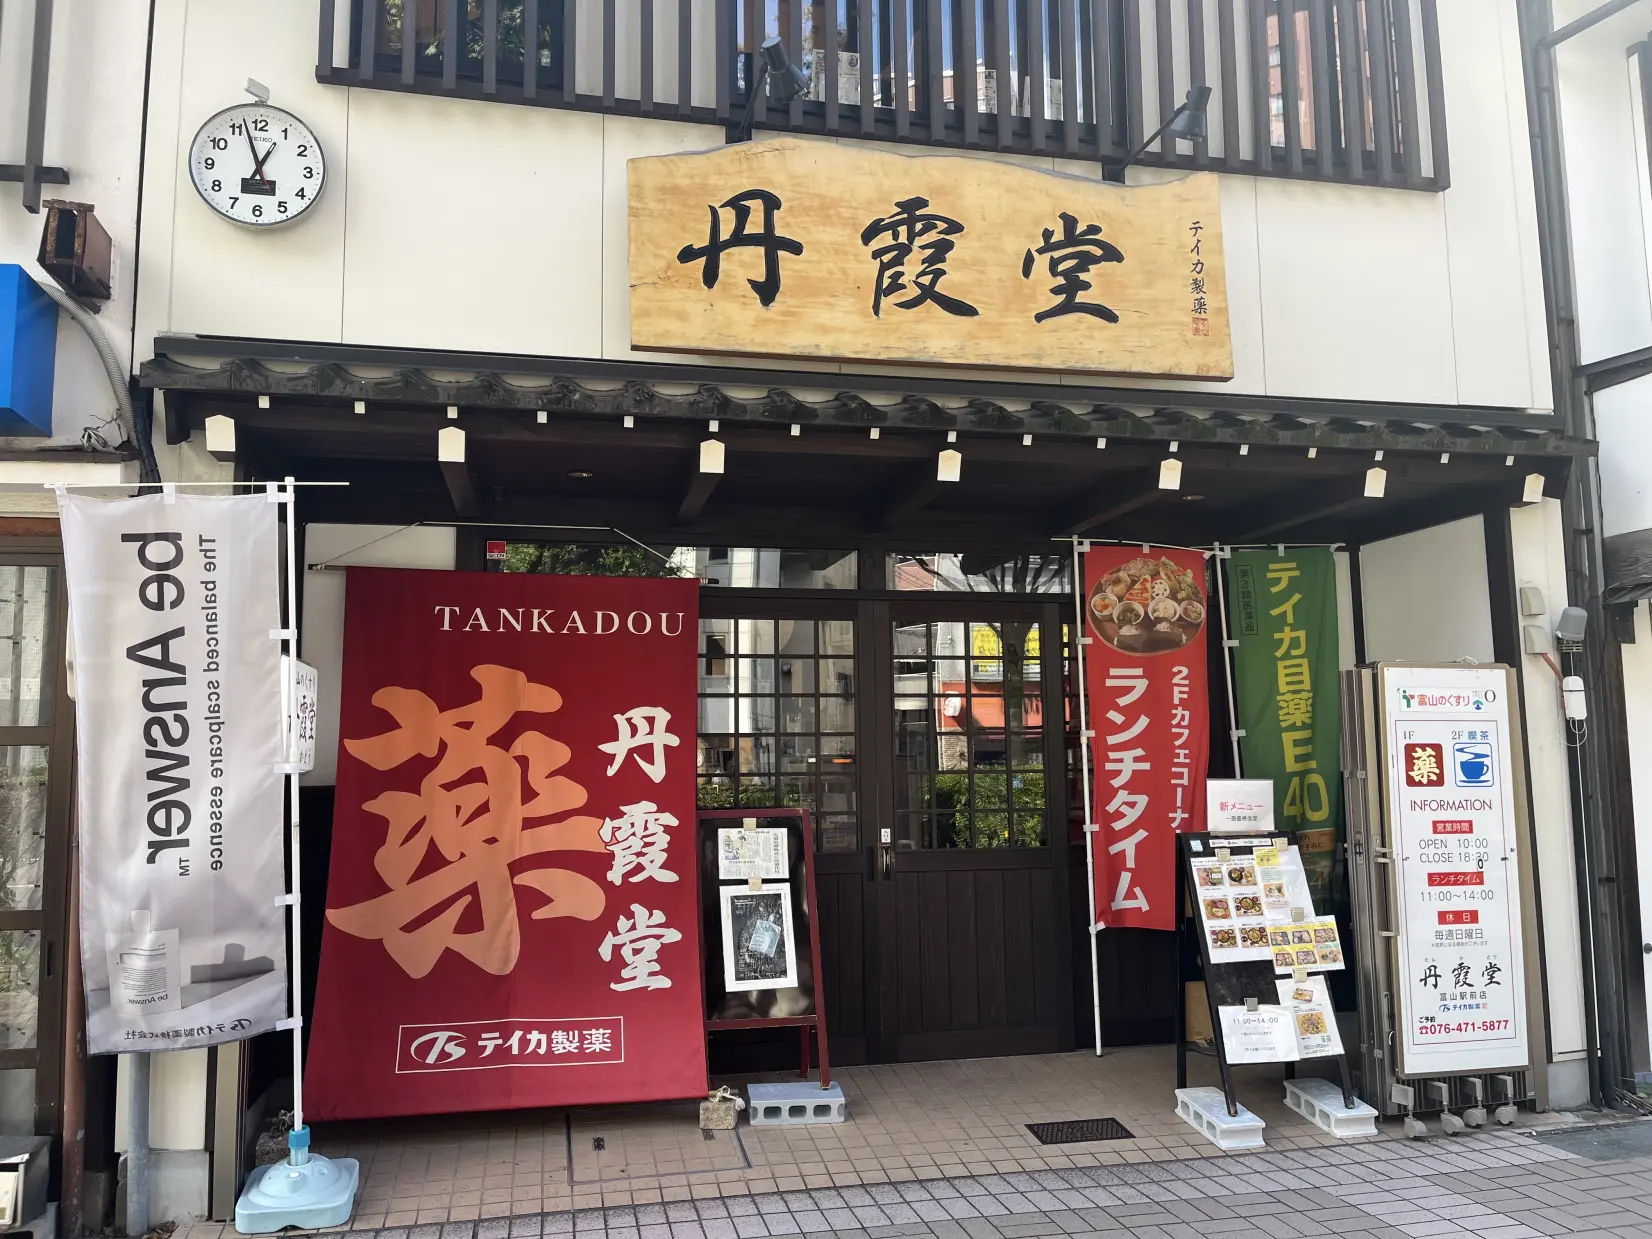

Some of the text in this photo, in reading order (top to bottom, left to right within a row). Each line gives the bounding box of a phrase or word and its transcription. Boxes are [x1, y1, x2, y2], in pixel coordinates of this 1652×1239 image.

[229, 123, 242, 136] 11
[252, 119, 269, 132] 12
[281, 128, 288, 140] 1
[210, 137, 228, 150] 10
[297, 144, 308, 157] 2
[204, 157, 215, 170] 9
[303, 166, 313, 179] 3
[211, 180, 222, 192] 8
[295, 187, 306, 200] 4
[229, 197, 239, 209] 7
[277, 201, 288, 213] 5
[252, 205, 263, 217] 6
[677, 188, 1124, 324] 丹霞堂
[1189, 221, 1208, 315] テイカ製薬
[434, 605, 685, 636] TANKADOU
[1418, 694, 1470, 707] 富山のくすり
[1404, 731, 1415, 740] 1F
[1451, 730, 1489, 741] 2F 喫茶
[1169, 666, 1191, 834] 2Fカフェコーナ
[1408, 747, 1440, 785] 薬
[1104, 668, 1151, 912] ランチタイム
[1220, 801, 1263, 812] 新メニュー
[1410, 799, 1492, 811] INFORMATION
[325, 664, 612, 979] 薬
[1436, 823, 1470, 833] 営業時間
[598, 706, 682, 992] 丹霞堂
[1419, 838, 1488, 850] OPEN 10:00
[1419, 852, 1454, 863] CLOSE
[1431, 874, 1480, 885] ランチタイム
[1435, 929, 1483, 940] 毎週日曜日
[1419, 961, 1502, 989] 丹霞堂
[1439, 990, 1487, 1001] 富山駅前店
[1429, 1019, 1509, 1035] 076-471-5877
[477, 1028, 612, 1058] テイカ製薬
